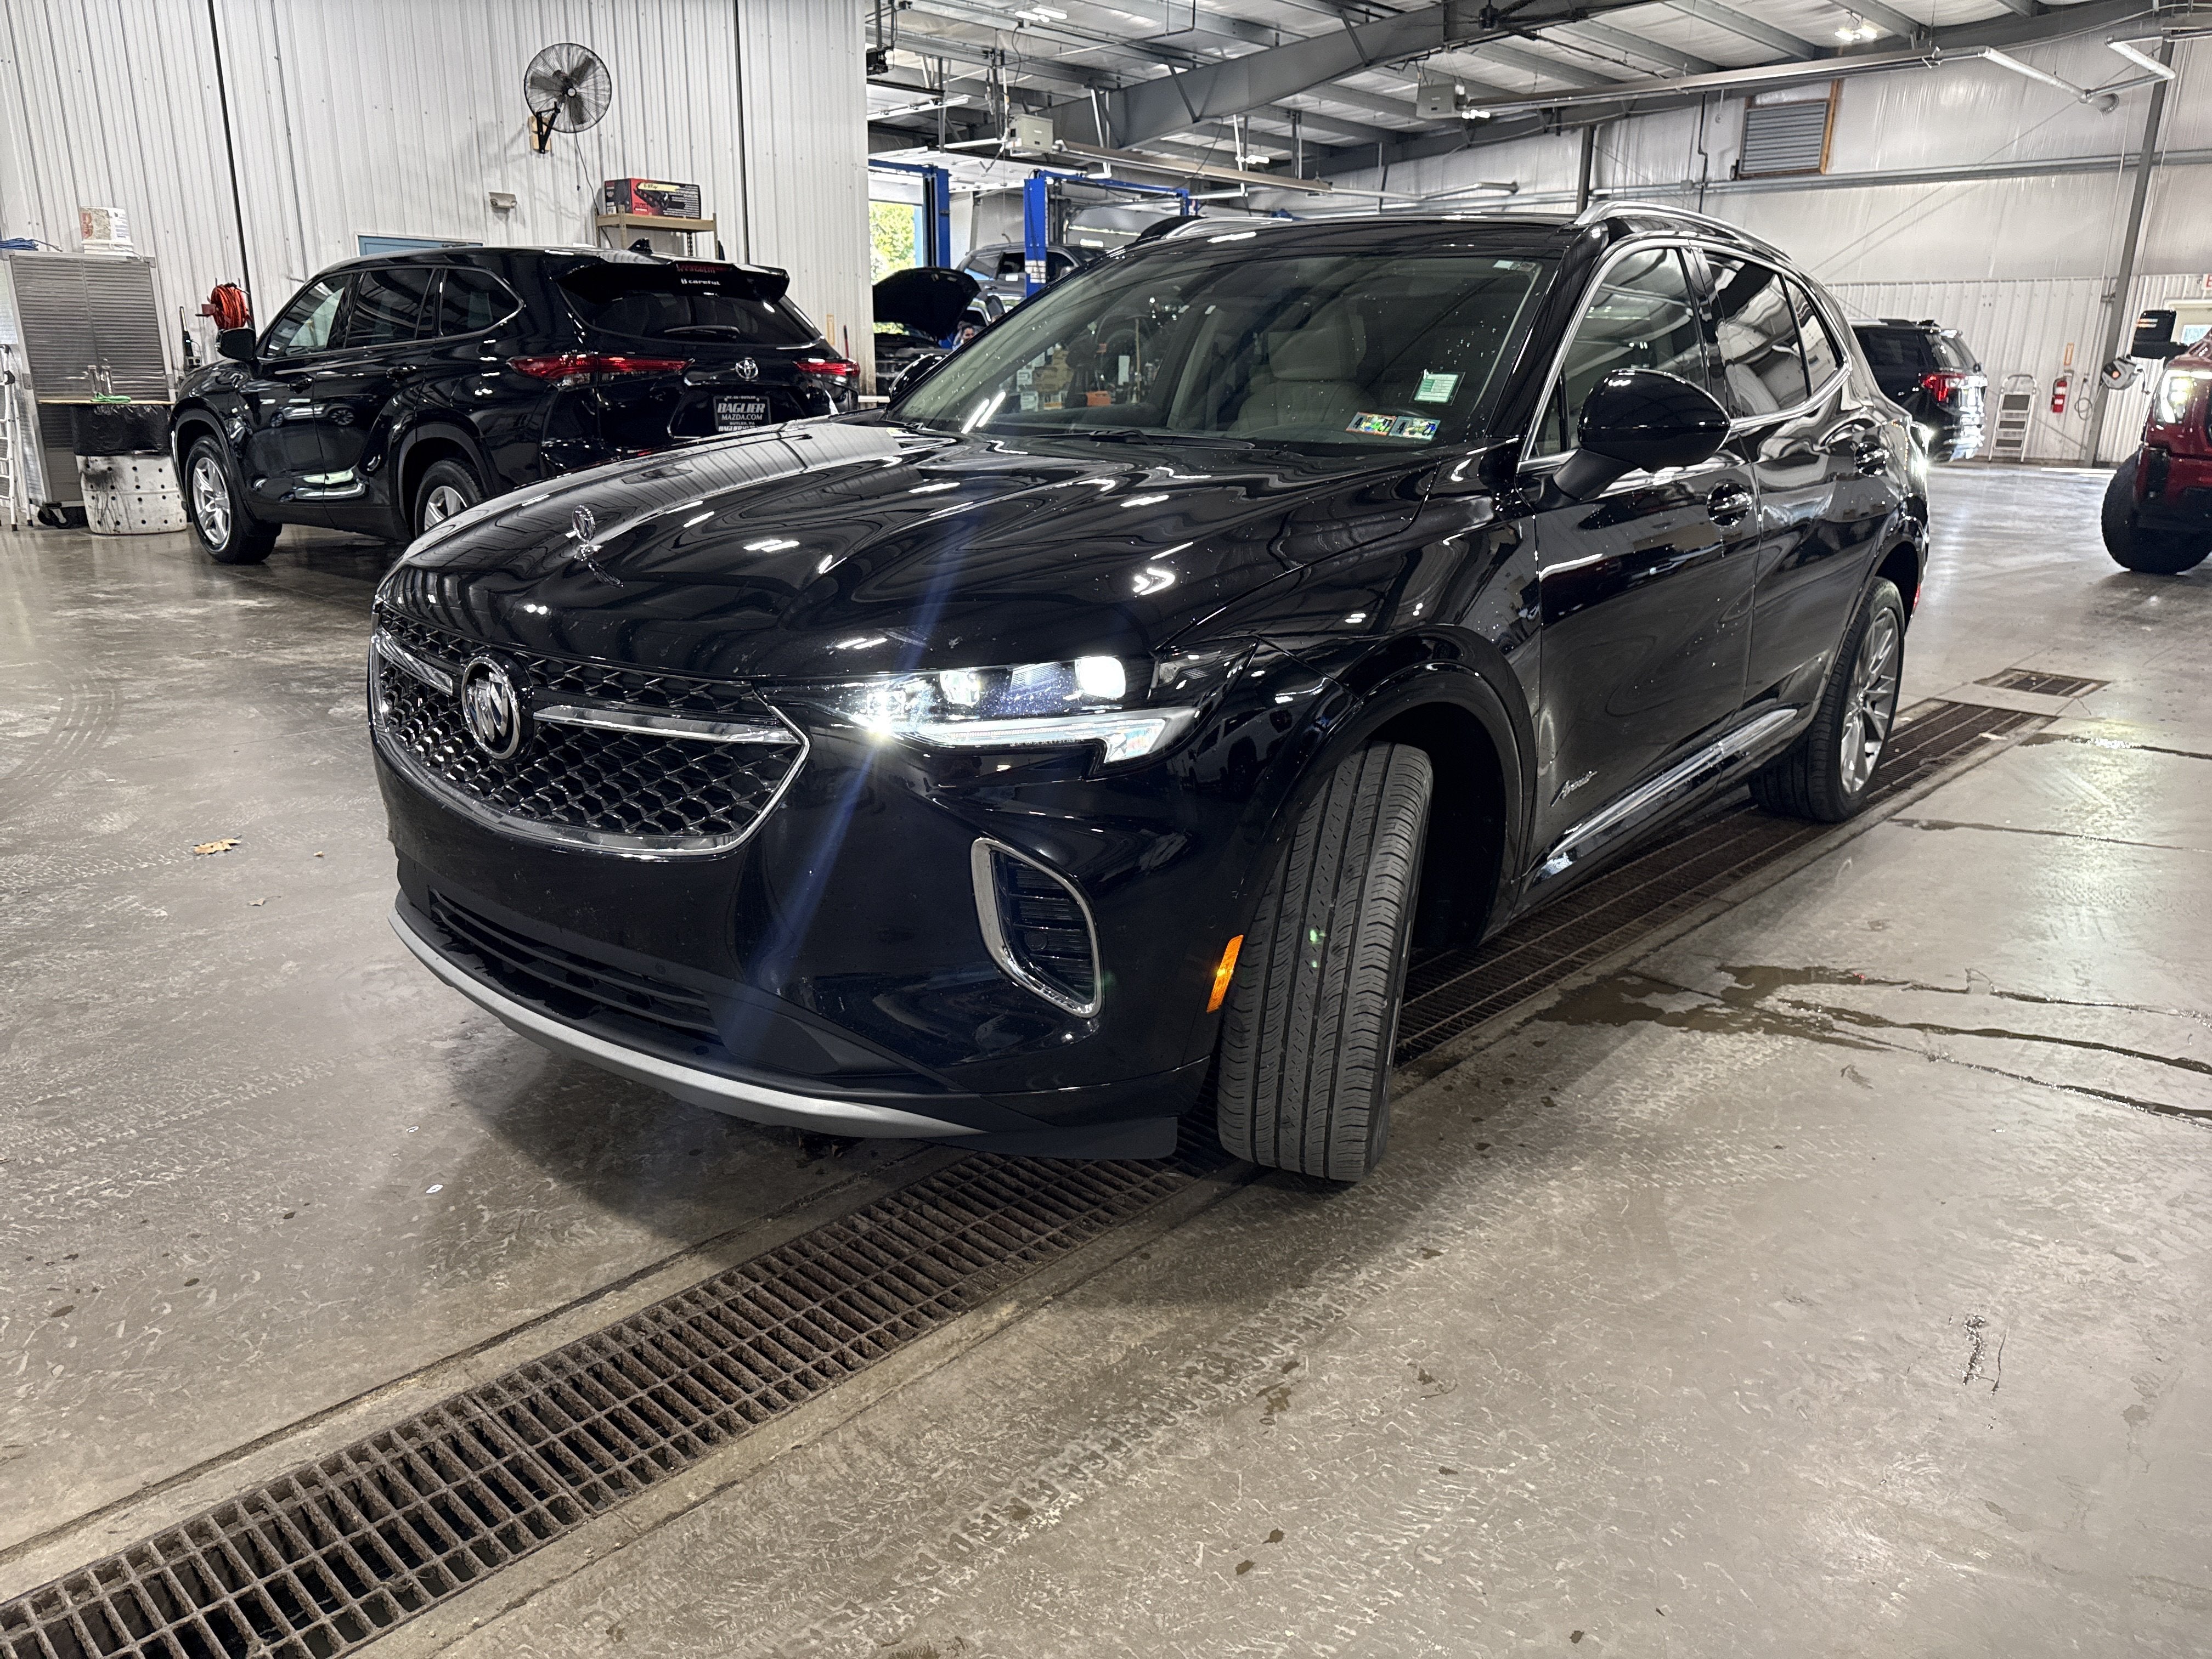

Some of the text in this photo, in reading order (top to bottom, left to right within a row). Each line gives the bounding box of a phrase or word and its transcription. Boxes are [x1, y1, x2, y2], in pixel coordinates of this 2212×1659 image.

[717, 403, 766, 413] BAGLIER
[1353, 417, 1364, 428] 4
[1398, 422, 1407, 434] 4
